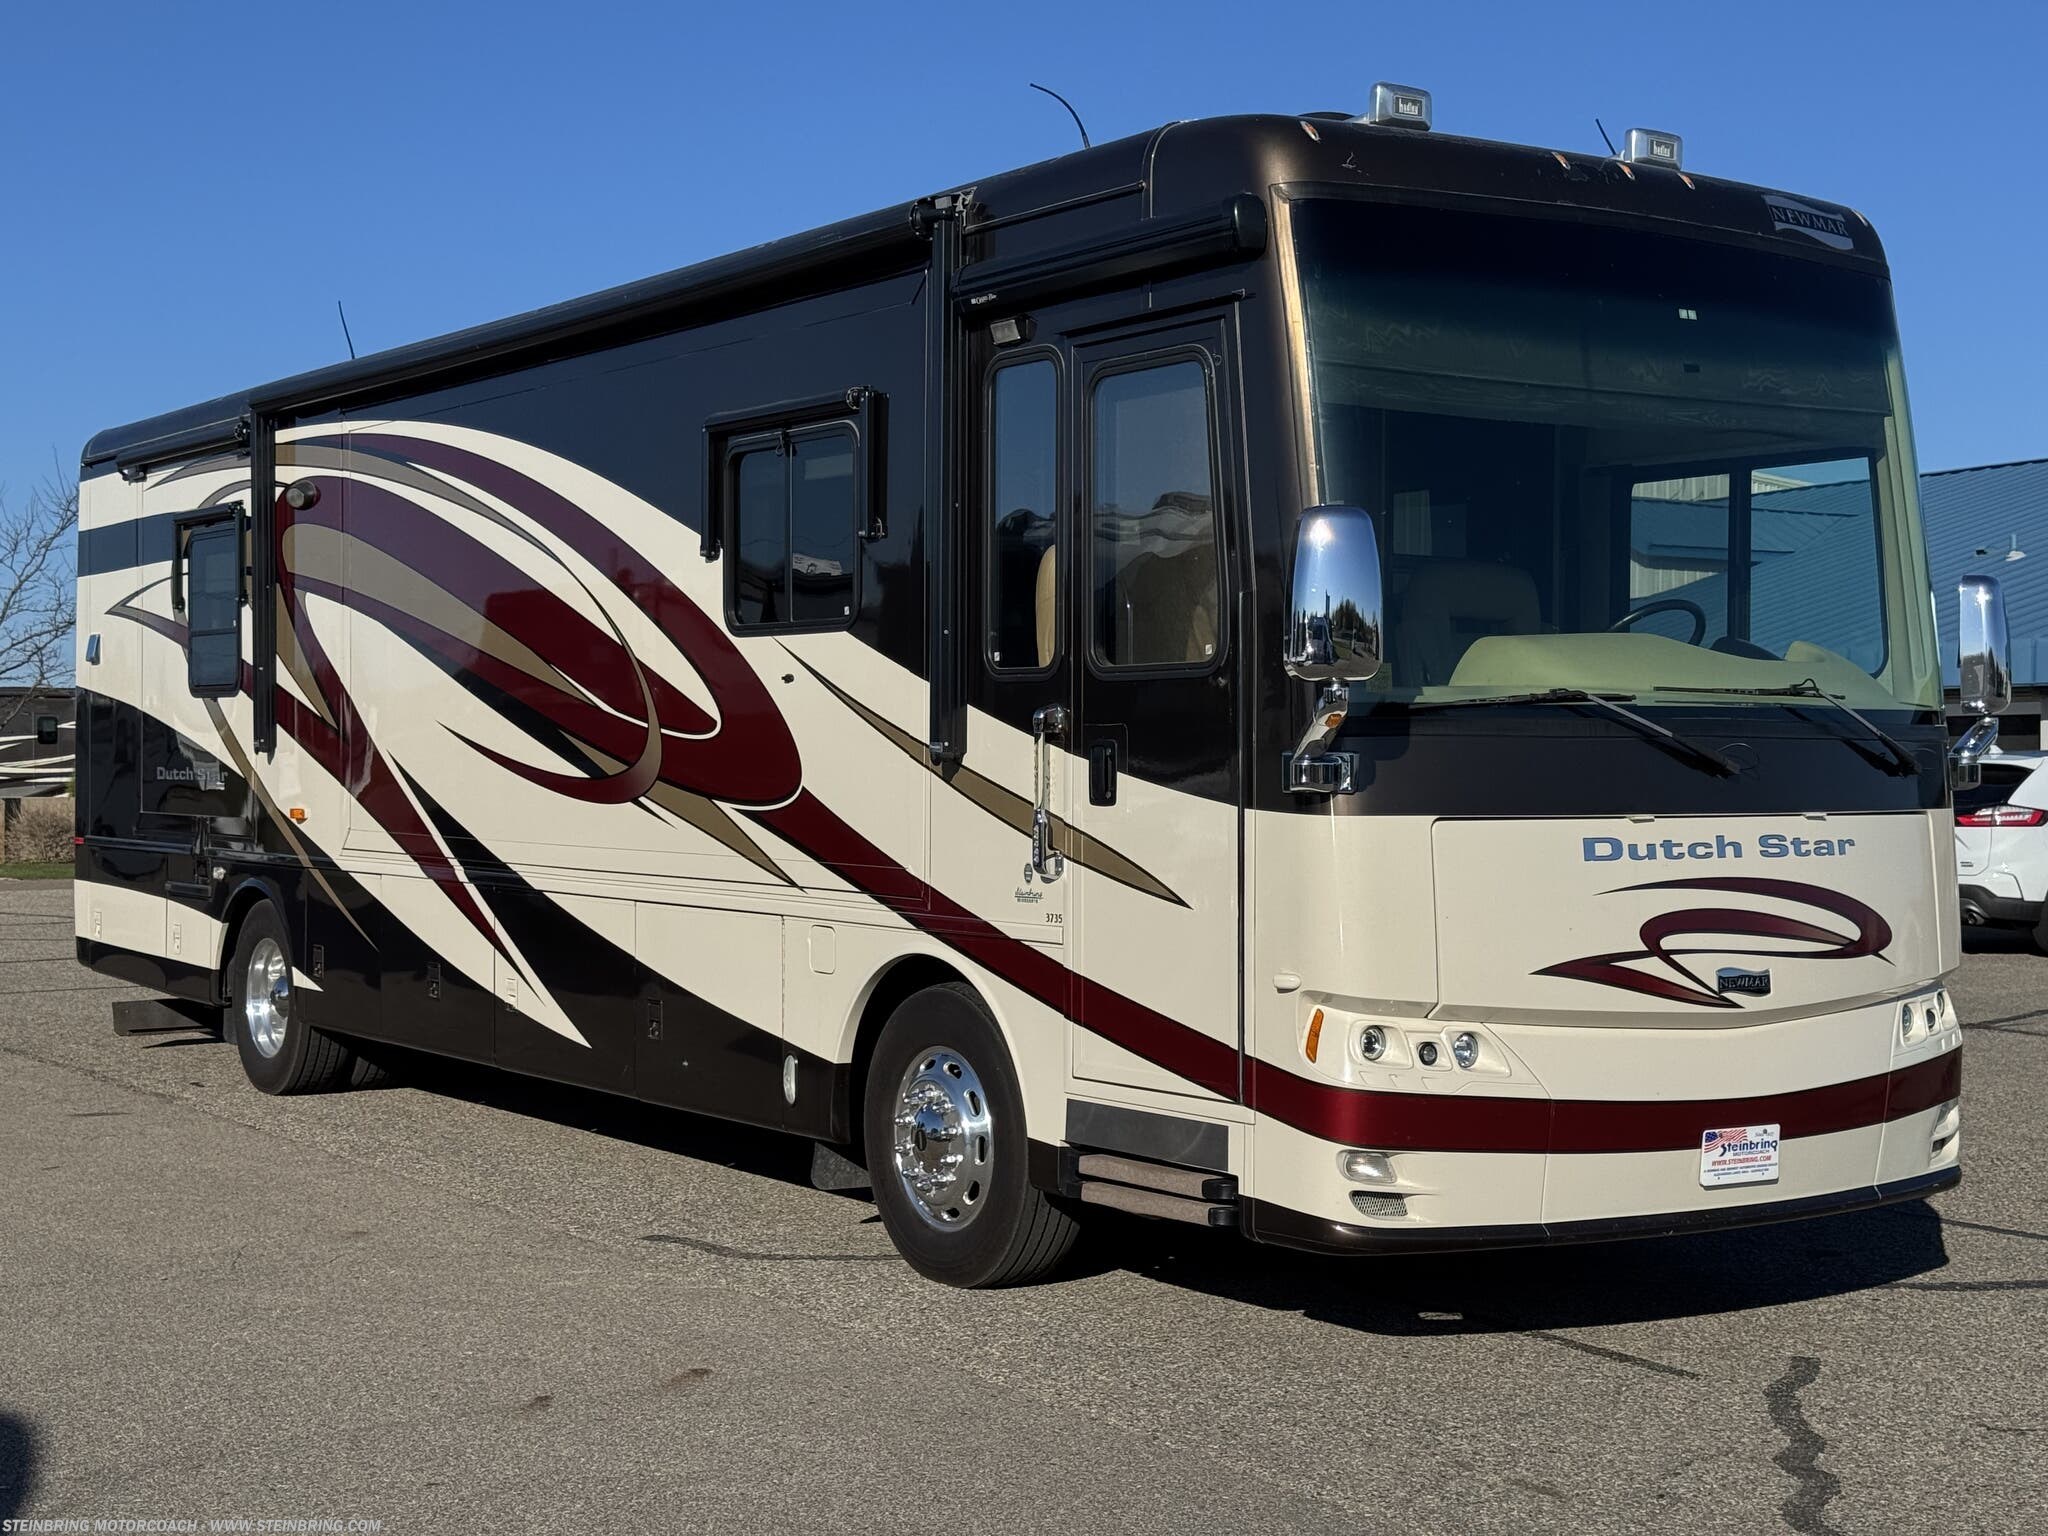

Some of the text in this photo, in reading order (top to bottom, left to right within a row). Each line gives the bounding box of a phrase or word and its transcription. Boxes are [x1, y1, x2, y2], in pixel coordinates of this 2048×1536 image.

[1769, 205, 1849, 236] NEWMAR
[156, 766, 193, 780] Dutch
[1582, 834, 1855, 862] Dutch Star
[1046, 912, 1063, 923] 3735
[1719, 976, 1768, 988] NEWMAR
[1719, 1138, 1777, 1157] Steinbring
